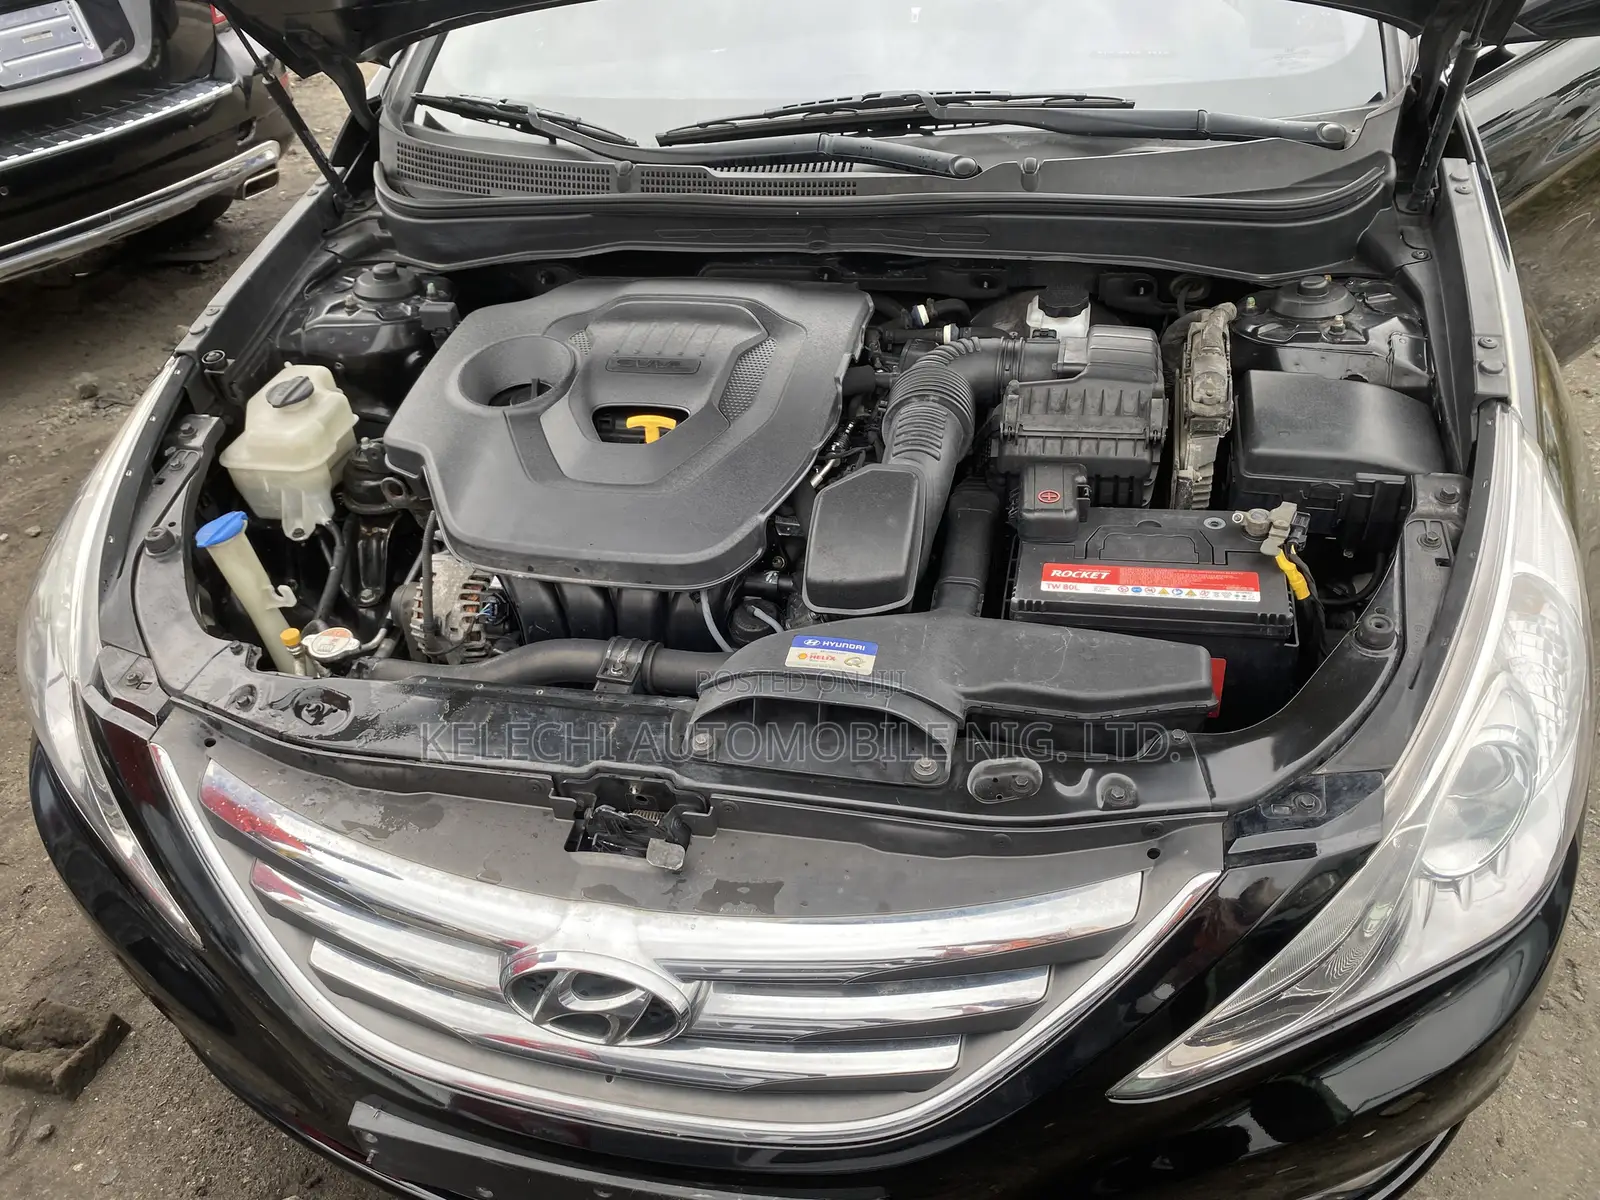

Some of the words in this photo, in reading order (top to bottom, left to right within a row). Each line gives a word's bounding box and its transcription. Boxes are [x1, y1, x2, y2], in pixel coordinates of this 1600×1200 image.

[1050, 569, 1111, 580] ROCKET
[1046, 582, 1062, 590] TW
[1062, 583, 1081, 591] 80L
[822, 640, 866, 652] HYUNDAI
[809, 652, 837, 662] HELIX
